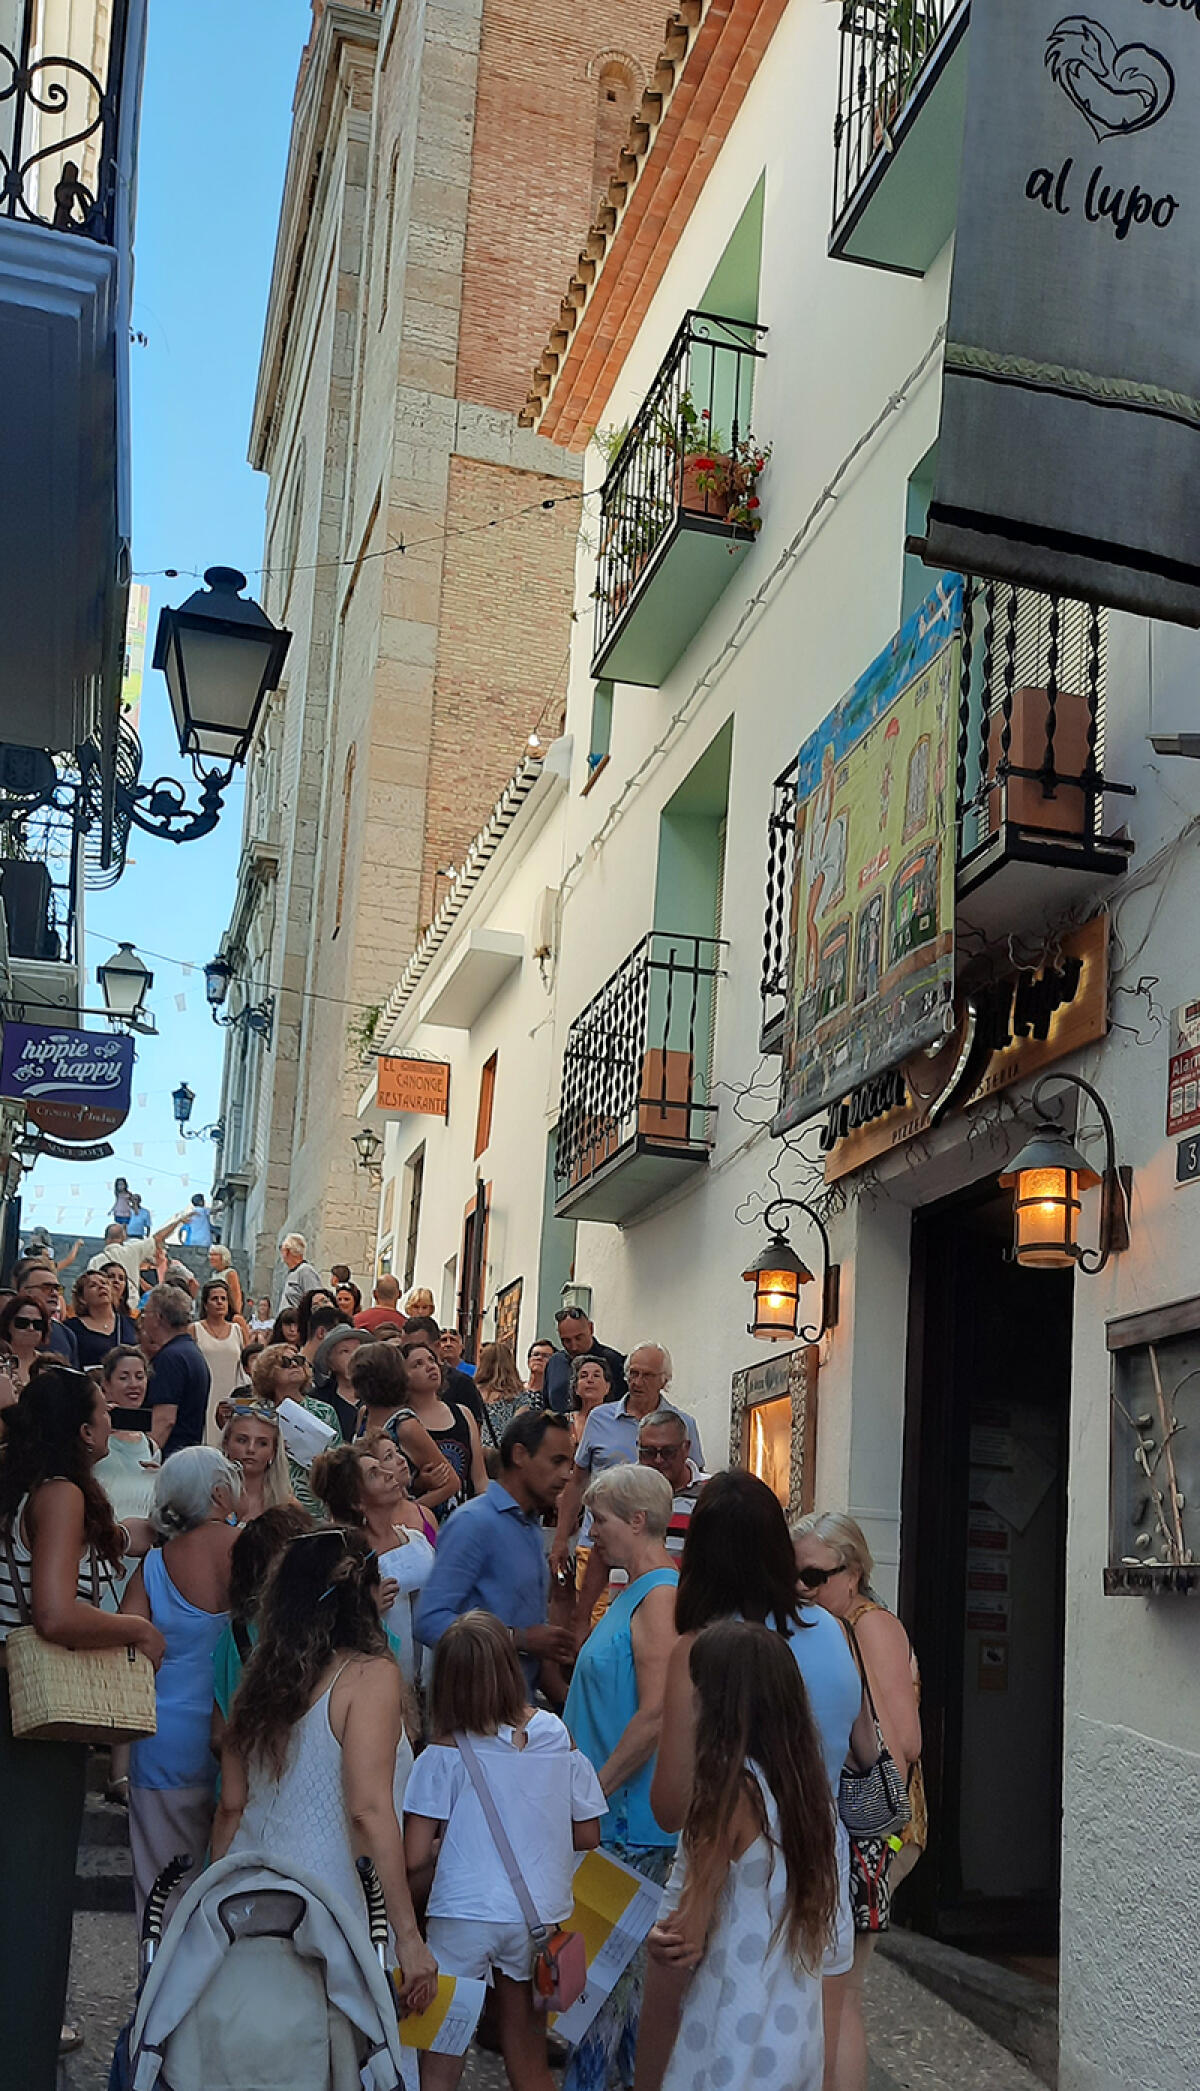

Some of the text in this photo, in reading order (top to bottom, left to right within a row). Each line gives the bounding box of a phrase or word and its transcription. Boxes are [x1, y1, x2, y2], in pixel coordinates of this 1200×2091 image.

[1025, 157, 1180, 241] al lupo
[21, 1037, 90, 1064] hippie
[53, 1059, 122, 1083] happy
[383, 1058, 395, 1072] EL
